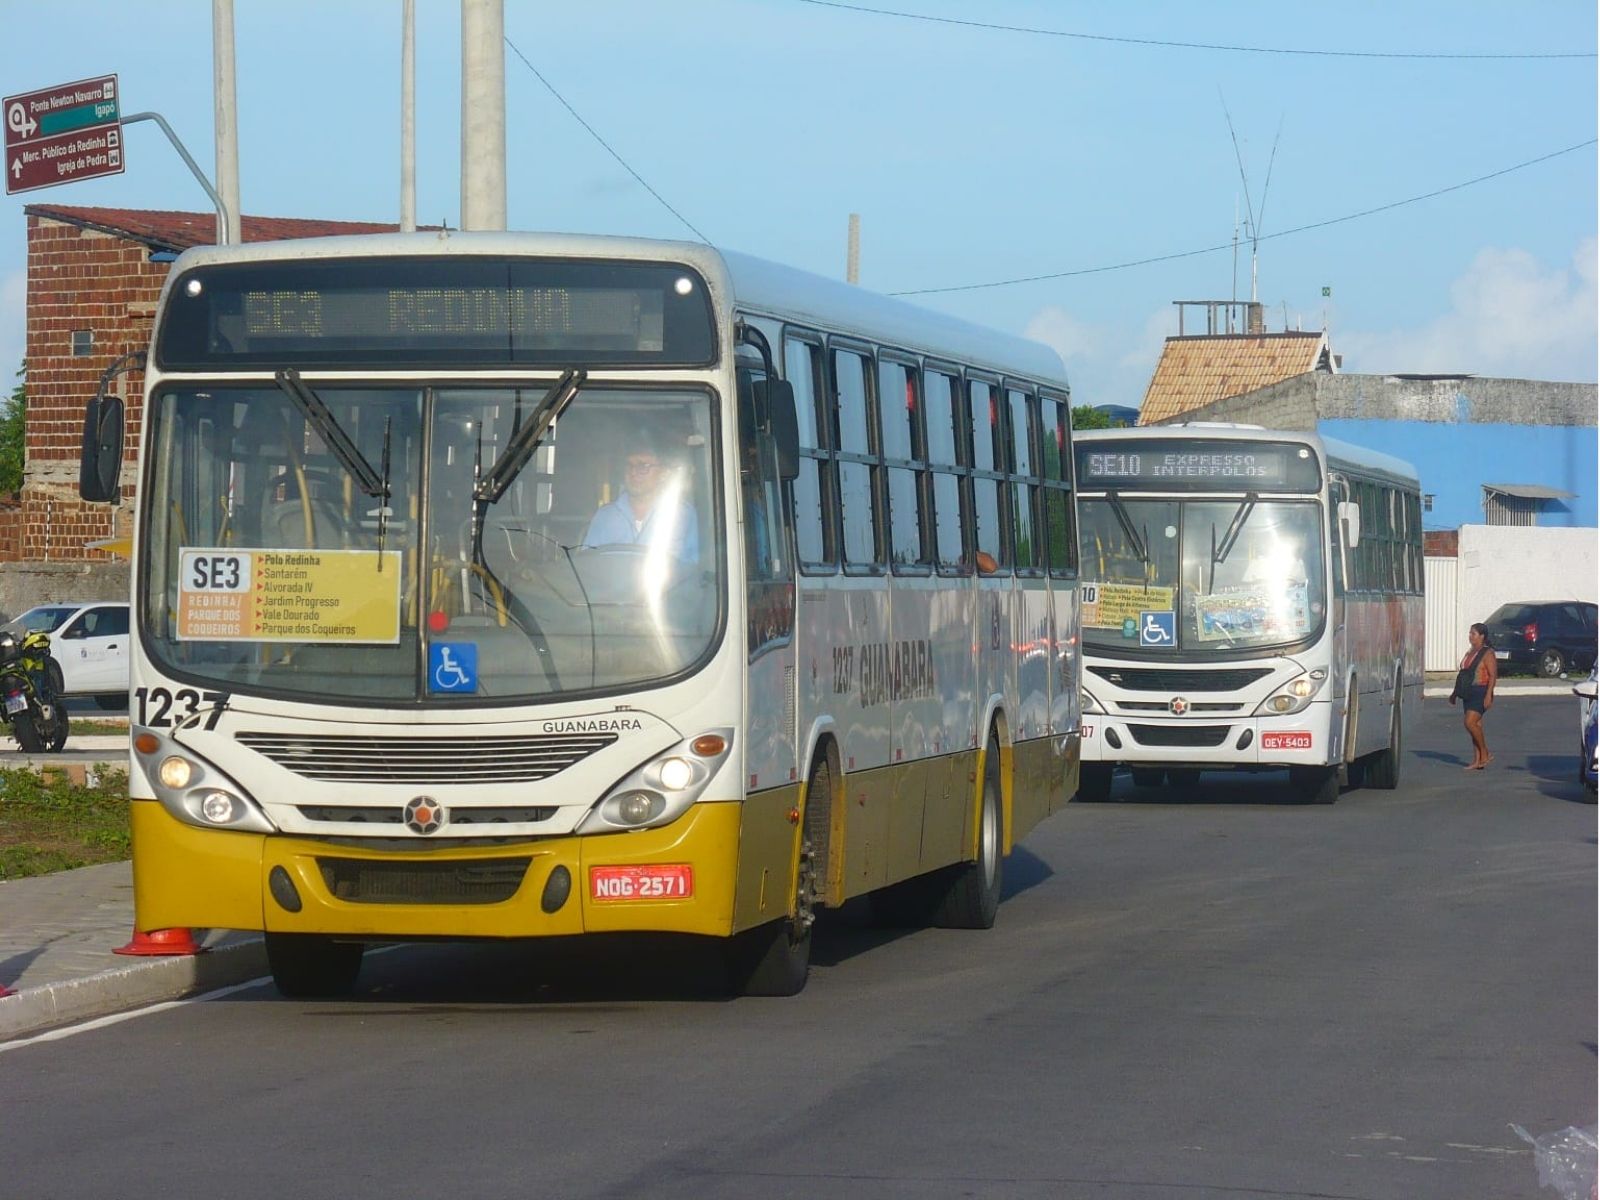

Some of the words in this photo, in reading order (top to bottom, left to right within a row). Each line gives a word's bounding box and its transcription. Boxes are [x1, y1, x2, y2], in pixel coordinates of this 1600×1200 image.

[50, 95, 74, 109] Newton
[75, 89, 101, 104] Navarro
[95, 102, 115, 118] Igapó
[23, 150, 41, 163] Merc.
[42, 144, 67, 159] Público
[68, 142, 76, 153] da
[77, 137, 106, 152] Redinha
[57, 161, 76, 175] Igreja
[77, 157, 85, 168] de
[86, 154, 106, 167] Pedra
[248, 290, 321, 333] SE3
[388, 288, 570, 333] REDINHA
[1089, 454, 1141, 476] SE10
[1164, 454, 1255, 465] EXPRESSO
[1152, 466, 1267, 477] INTERPOLOS
[265, 554, 284, 566] Polo
[285, 555, 320, 566] Redinha
[193, 556, 240, 589] SE3
[264, 568, 308, 579] Santarém
[263, 582, 303, 593] Alvorada
[304, 582, 313, 593] IV
[189, 595, 242, 607] REDINHA/
[263, 595, 293, 606] Jardim
[295, 597, 339, 609] Progresso
[188, 610, 222, 621] PARQUE
[223, 610, 241, 620] DOS
[262, 609, 282, 620] Vale
[284, 609, 319, 620] Dourado
[187, 623, 241, 635] COQUEIROS
[262, 623, 293, 636] Parque
[294, 623, 311, 634] dos
[312, 624, 356, 637] Coqueiros
[832, 646, 854, 694] 1237
[859, 640, 935, 708] GUANABARA
[135, 687, 232, 731] 1237
[542, 719, 642, 733] GUANABARA
